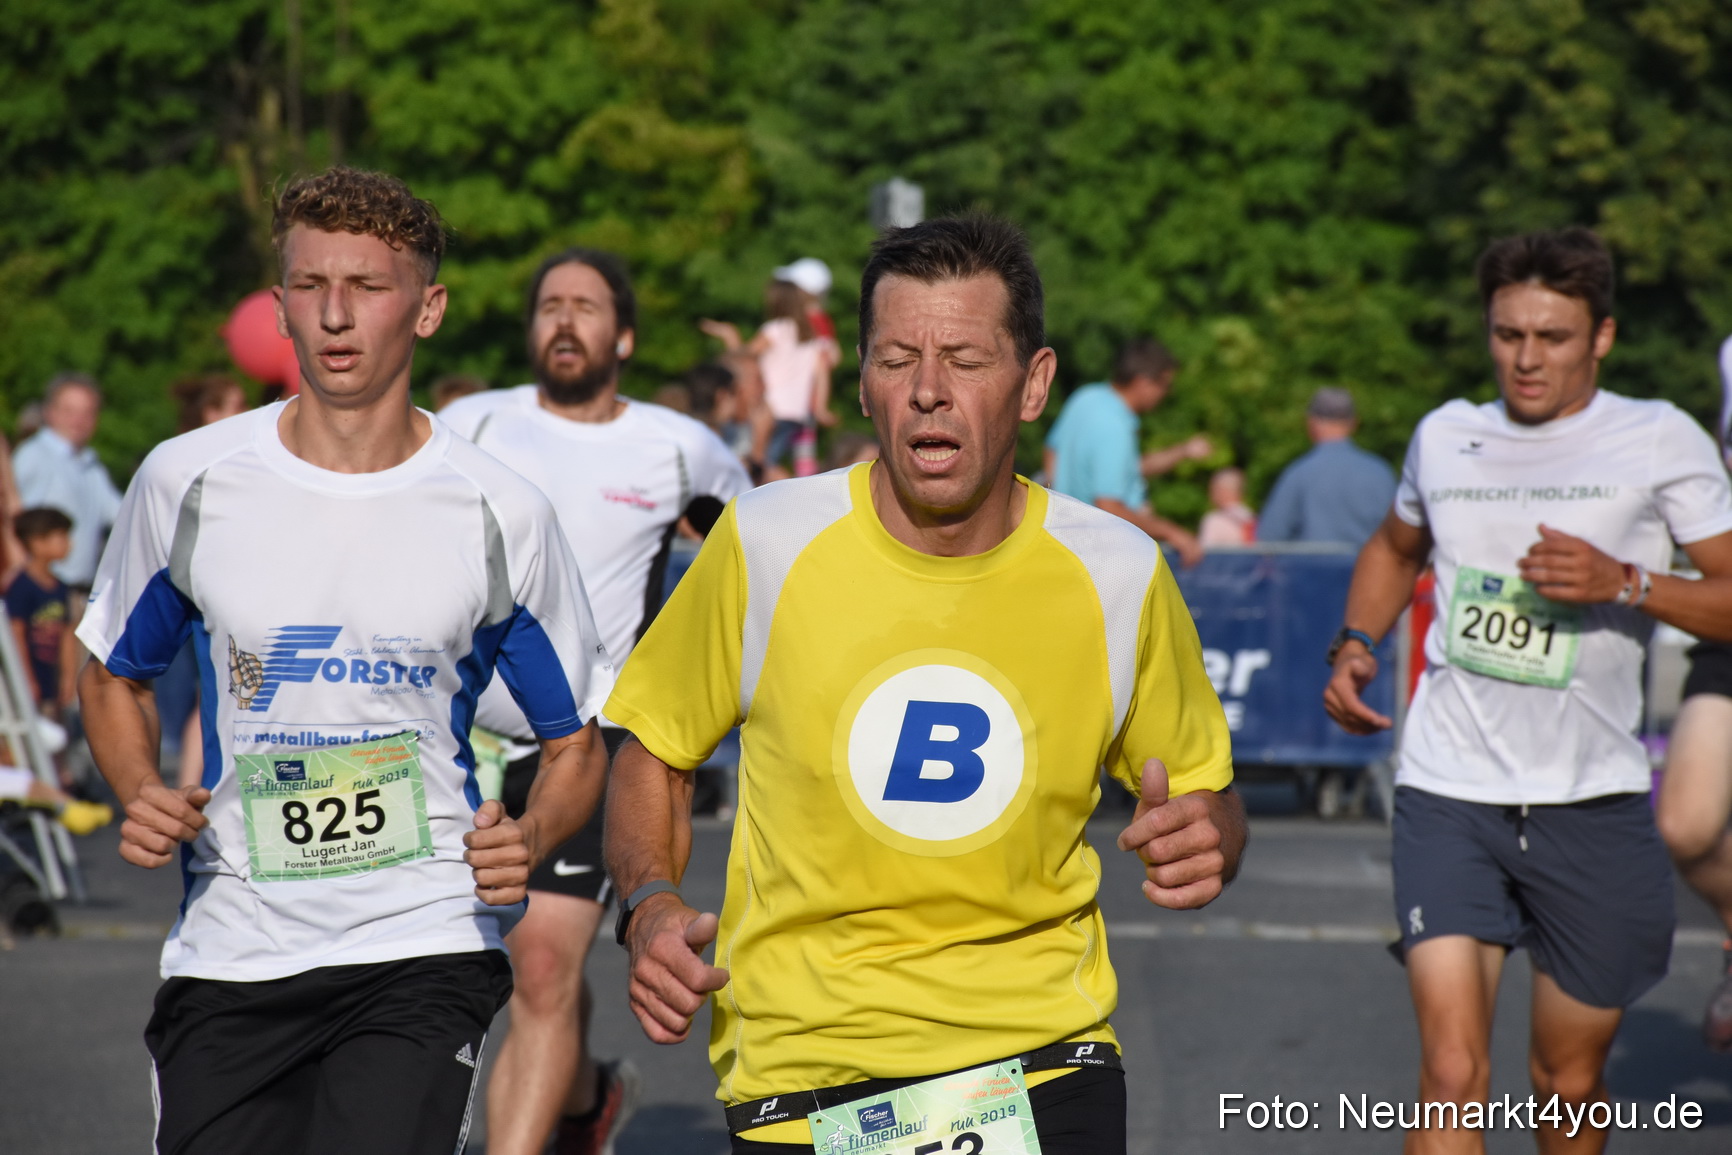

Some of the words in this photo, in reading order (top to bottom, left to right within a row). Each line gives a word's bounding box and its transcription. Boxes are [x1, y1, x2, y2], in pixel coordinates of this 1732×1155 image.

[1530, 485, 1617, 501] HOLZBAU
[1460, 606, 1556, 656] 2091
[250, 625, 437, 713] FORSTER
[1202, 648, 1272, 697] er
[882, 700, 991, 803] B
[265, 774, 335, 791] firmenlauf
[352, 778, 373, 790] run
[378, 768, 409, 785] 2019
[282, 789, 386, 845] 825
[284, 861, 317, 869] Forster
[320, 855, 365, 867] Metallbau
[367, 846, 396, 859] GmbH
[302, 844, 347, 859] Lugert
[351, 840, 376, 852] Jan
[455, 1054, 475, 1068] adidas
[751, 1116, 765, 1124] PRO
[766, 1112, 789, 1121] TOUCH
[865, 1110, 888, 1120] Fischer
[950, 1116, 974, 1132] run
[980, 1104, 1016, 1125] 2019
[848, 1113, 928, 1150] firmenlauf
